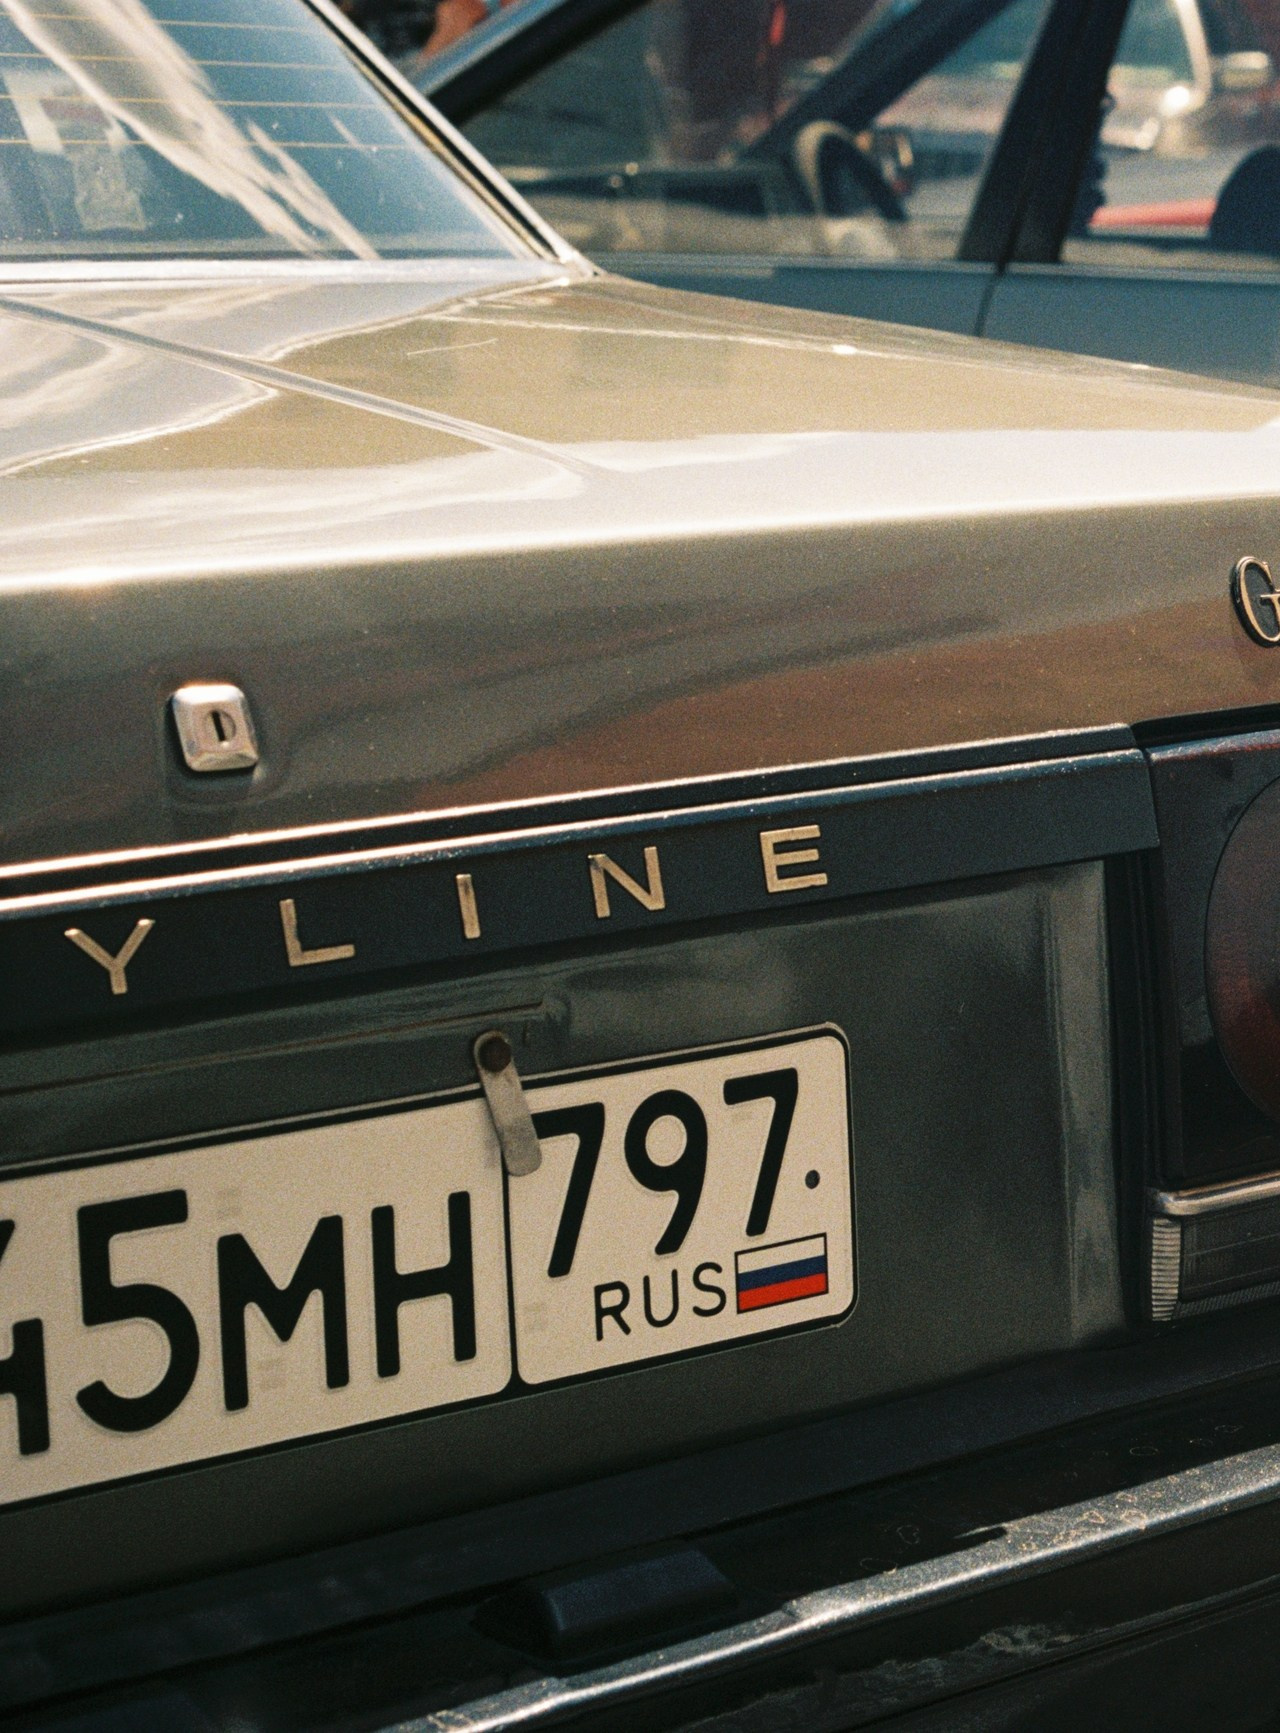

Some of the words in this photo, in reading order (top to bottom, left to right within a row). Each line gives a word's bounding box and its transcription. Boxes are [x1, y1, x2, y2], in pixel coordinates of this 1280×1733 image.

[63, 824, 829, 995] YLINE
[530, 1066, 801, 1278] 797
[594, 1261, 728, 1342] RUS
